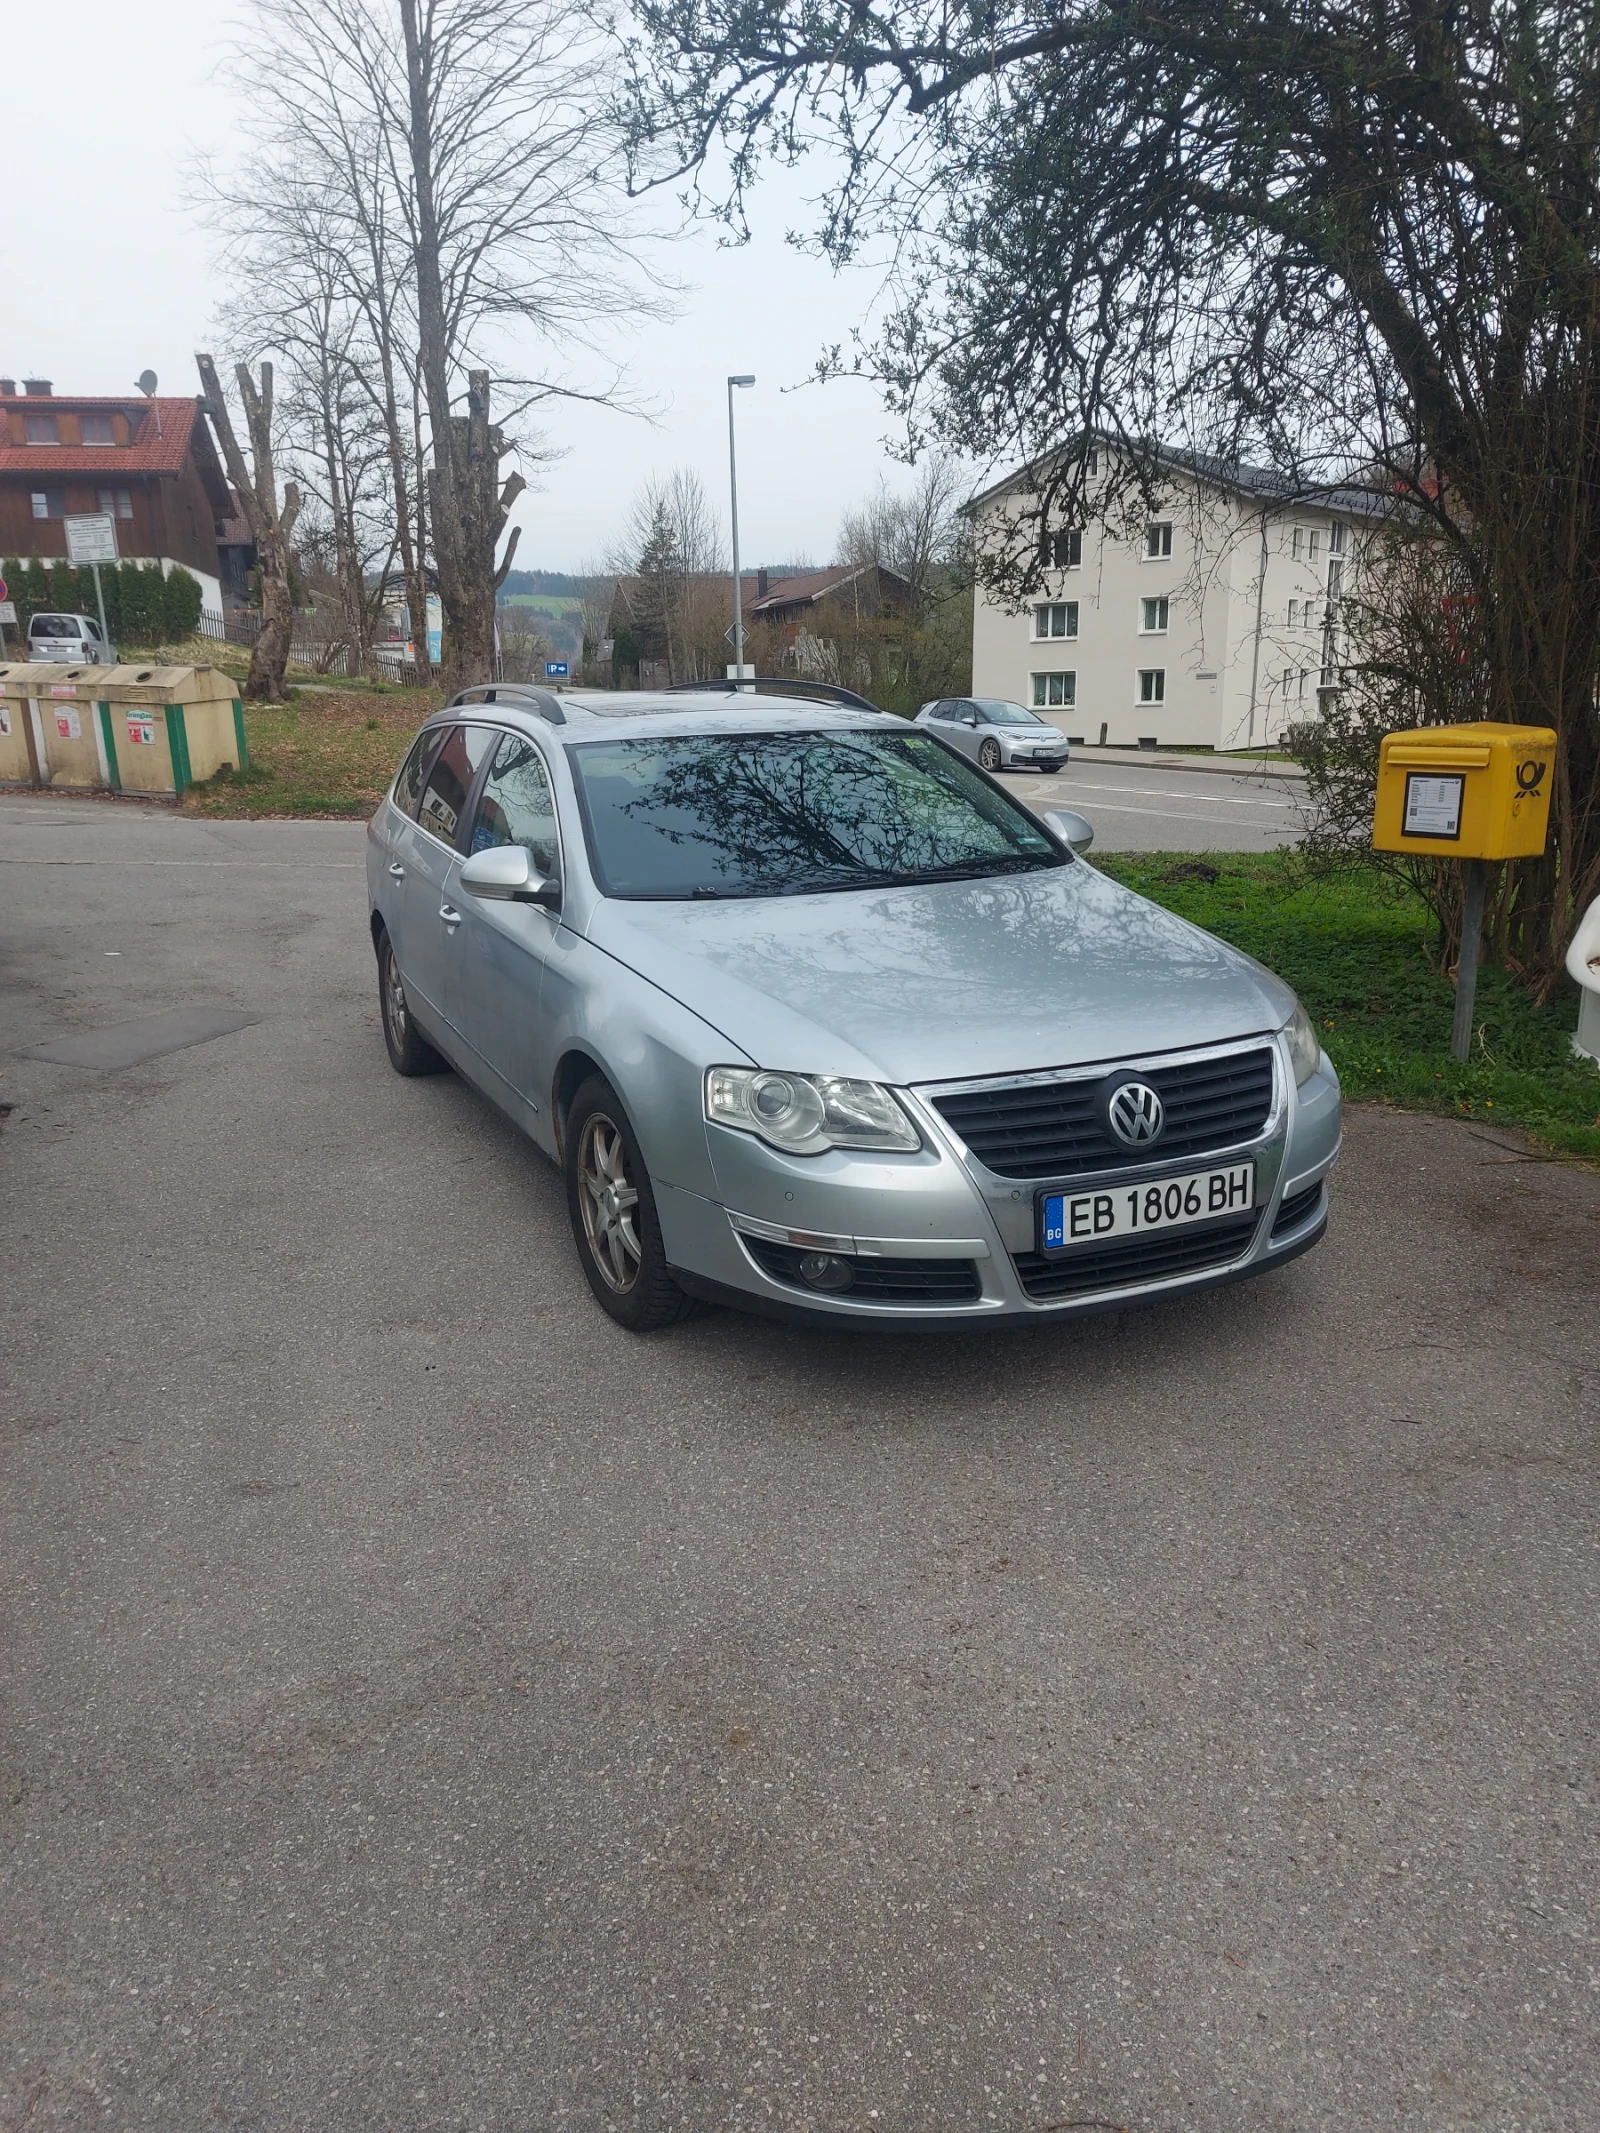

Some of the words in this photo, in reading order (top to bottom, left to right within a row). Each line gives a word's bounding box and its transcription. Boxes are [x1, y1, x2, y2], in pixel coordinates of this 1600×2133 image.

[1110, 1083, 1163, 1146] VW
[1047, 1227, 1062, 1241] BG
[1070, 1195, 1115, 1238] EB
[1127, 1179, 1201, 1227] 1806
[1208, 1168, 1248, 1212] BH
